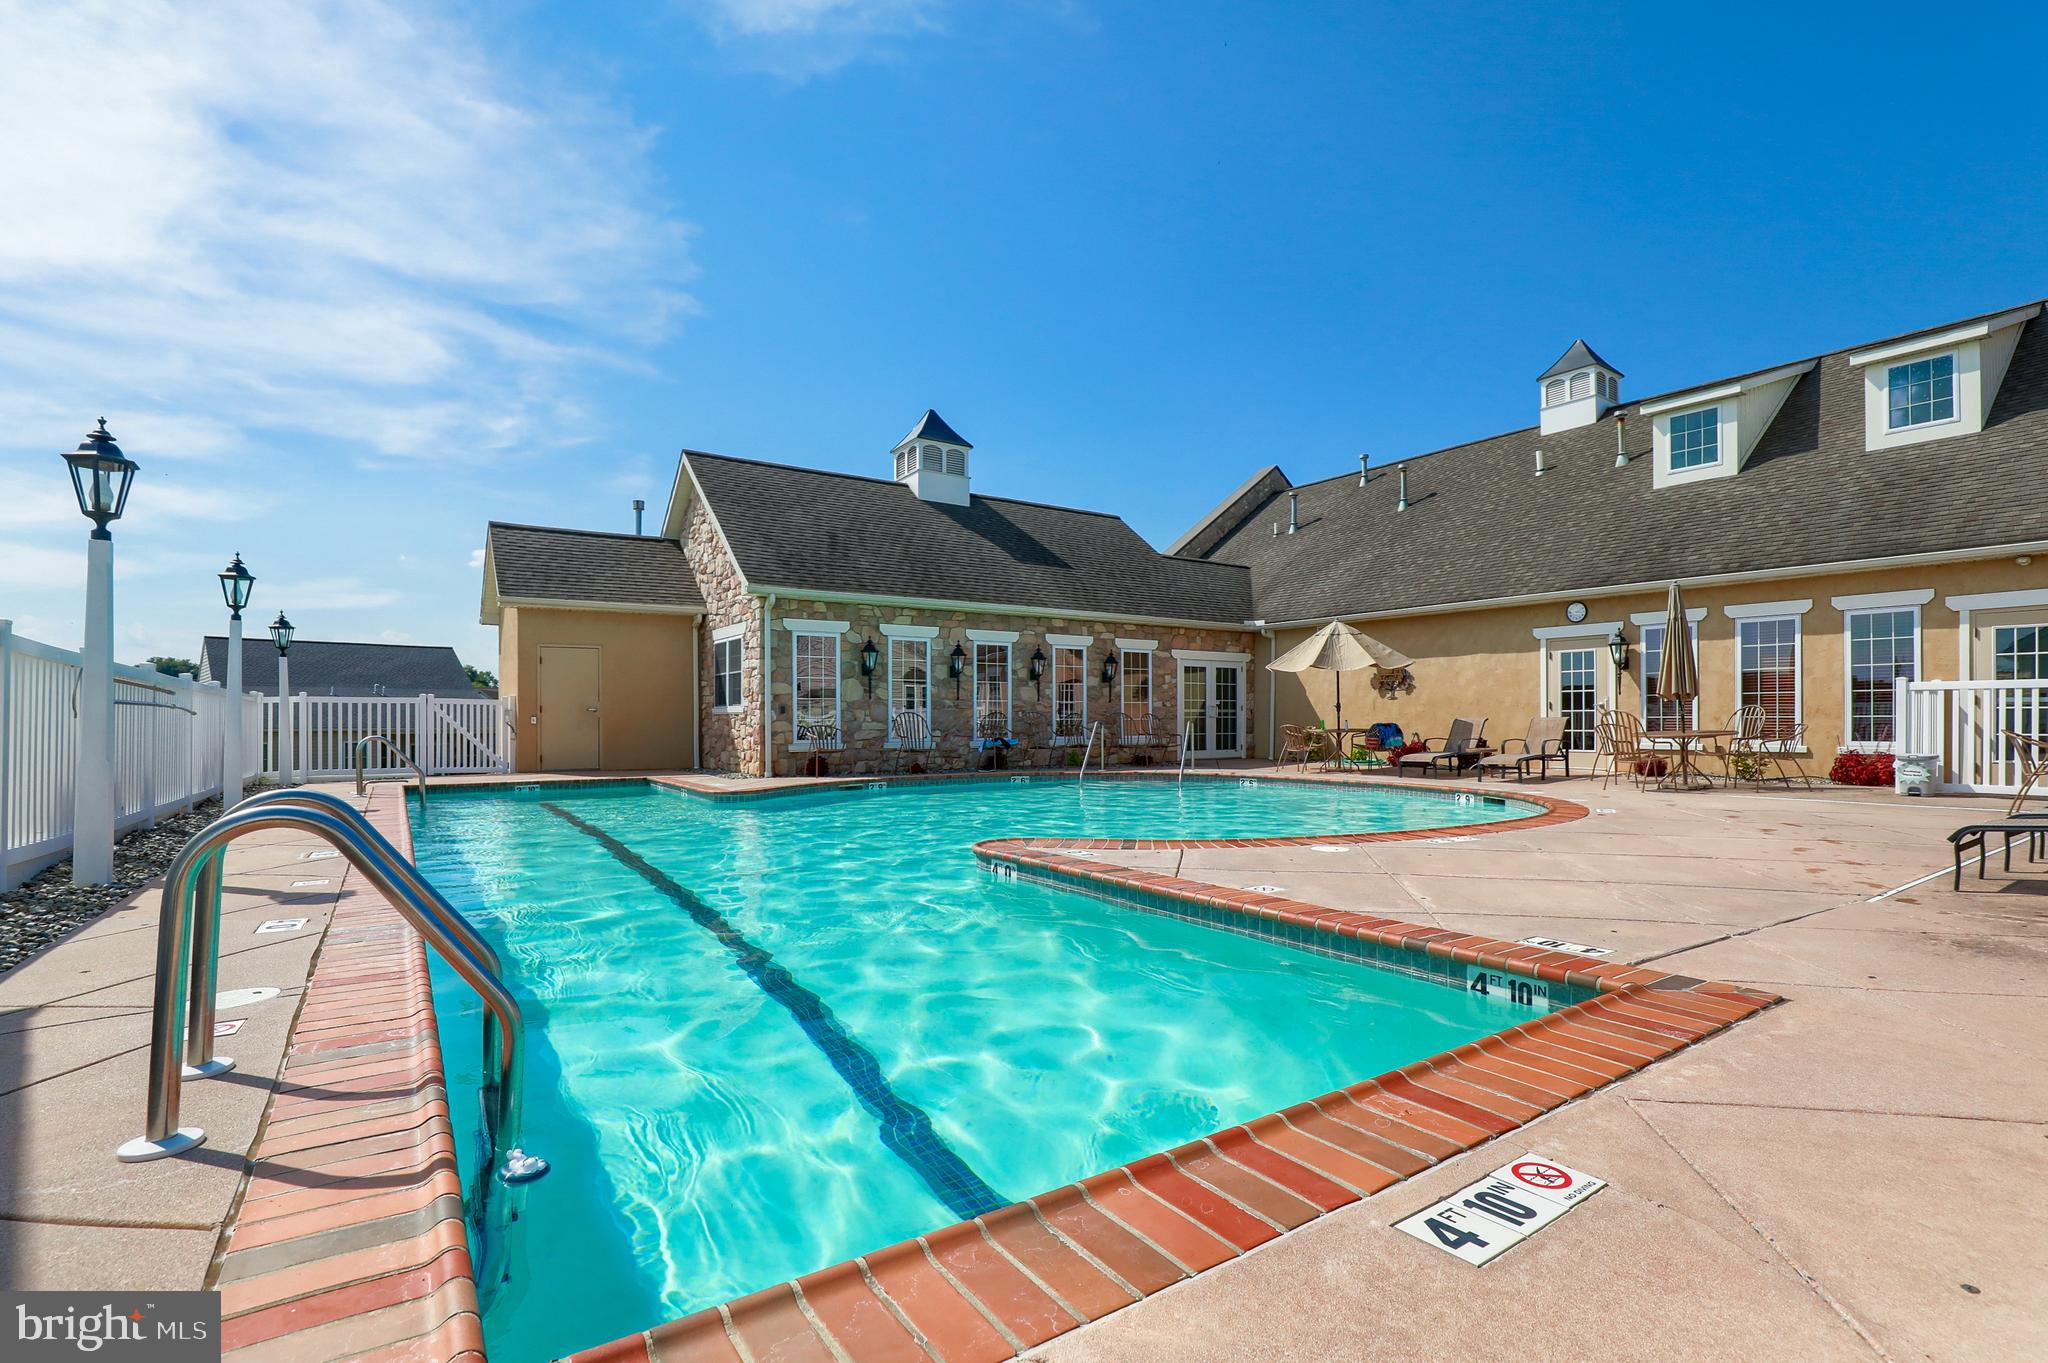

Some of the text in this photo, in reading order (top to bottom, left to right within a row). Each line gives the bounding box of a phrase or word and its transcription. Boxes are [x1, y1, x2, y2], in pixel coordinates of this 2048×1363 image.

[1471, 972, 1547, 1006] 4 FT 10 IN
[1563, 1180, 1597, 1201] NO DIVING
[1424, 1181, 1538, 1250] 4 FT 10 IN
